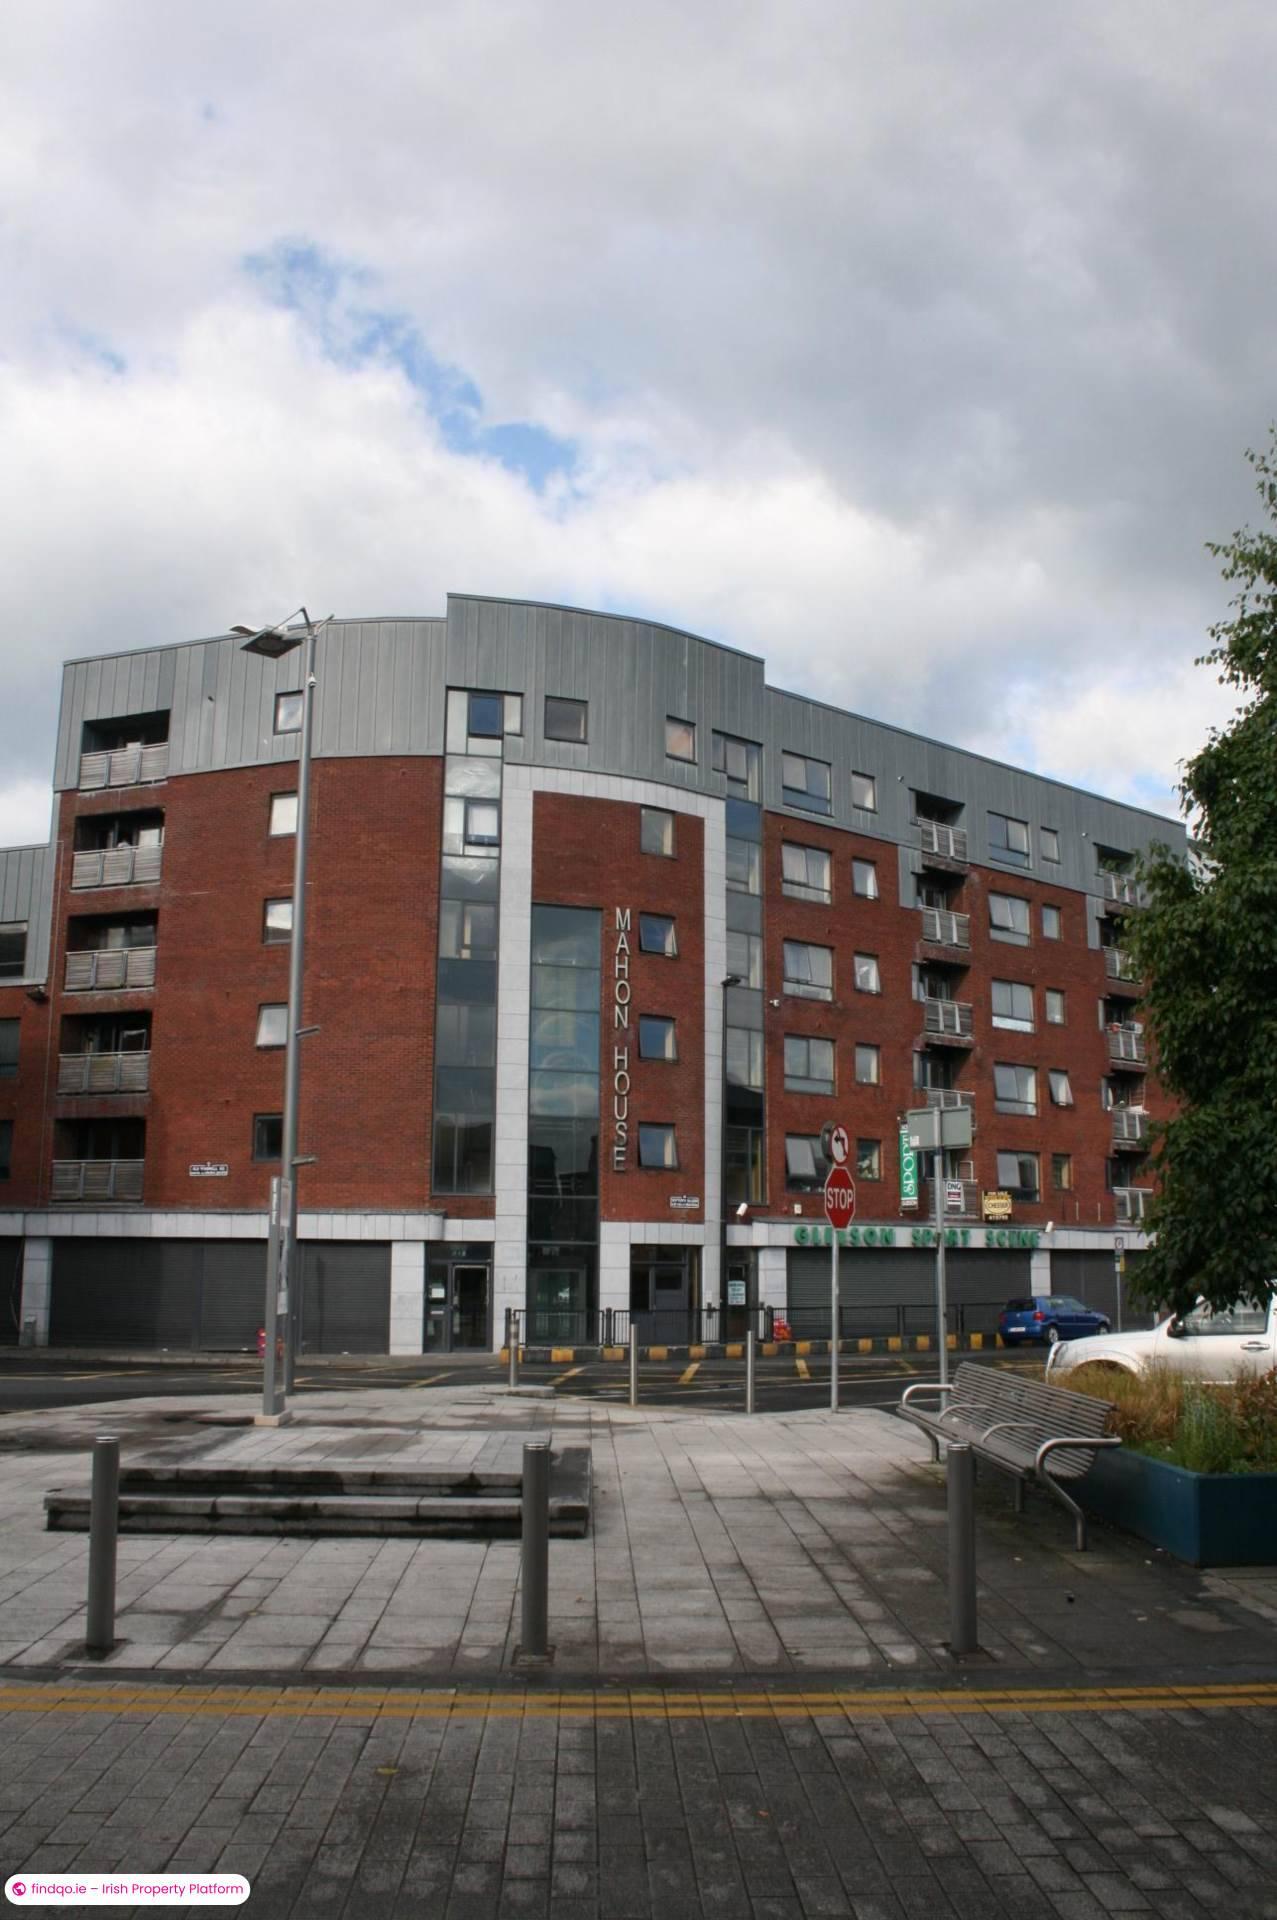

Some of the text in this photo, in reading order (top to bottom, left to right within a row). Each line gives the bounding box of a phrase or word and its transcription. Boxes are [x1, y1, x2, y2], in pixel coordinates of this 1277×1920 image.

[613, 907, 631, 1172] MAHON HOUSE
[827, 1187, 854, 1209] STOP
[911, 1228, 970, 1247] SPRT
[985, 1229, 1039, 1248] SCENE
